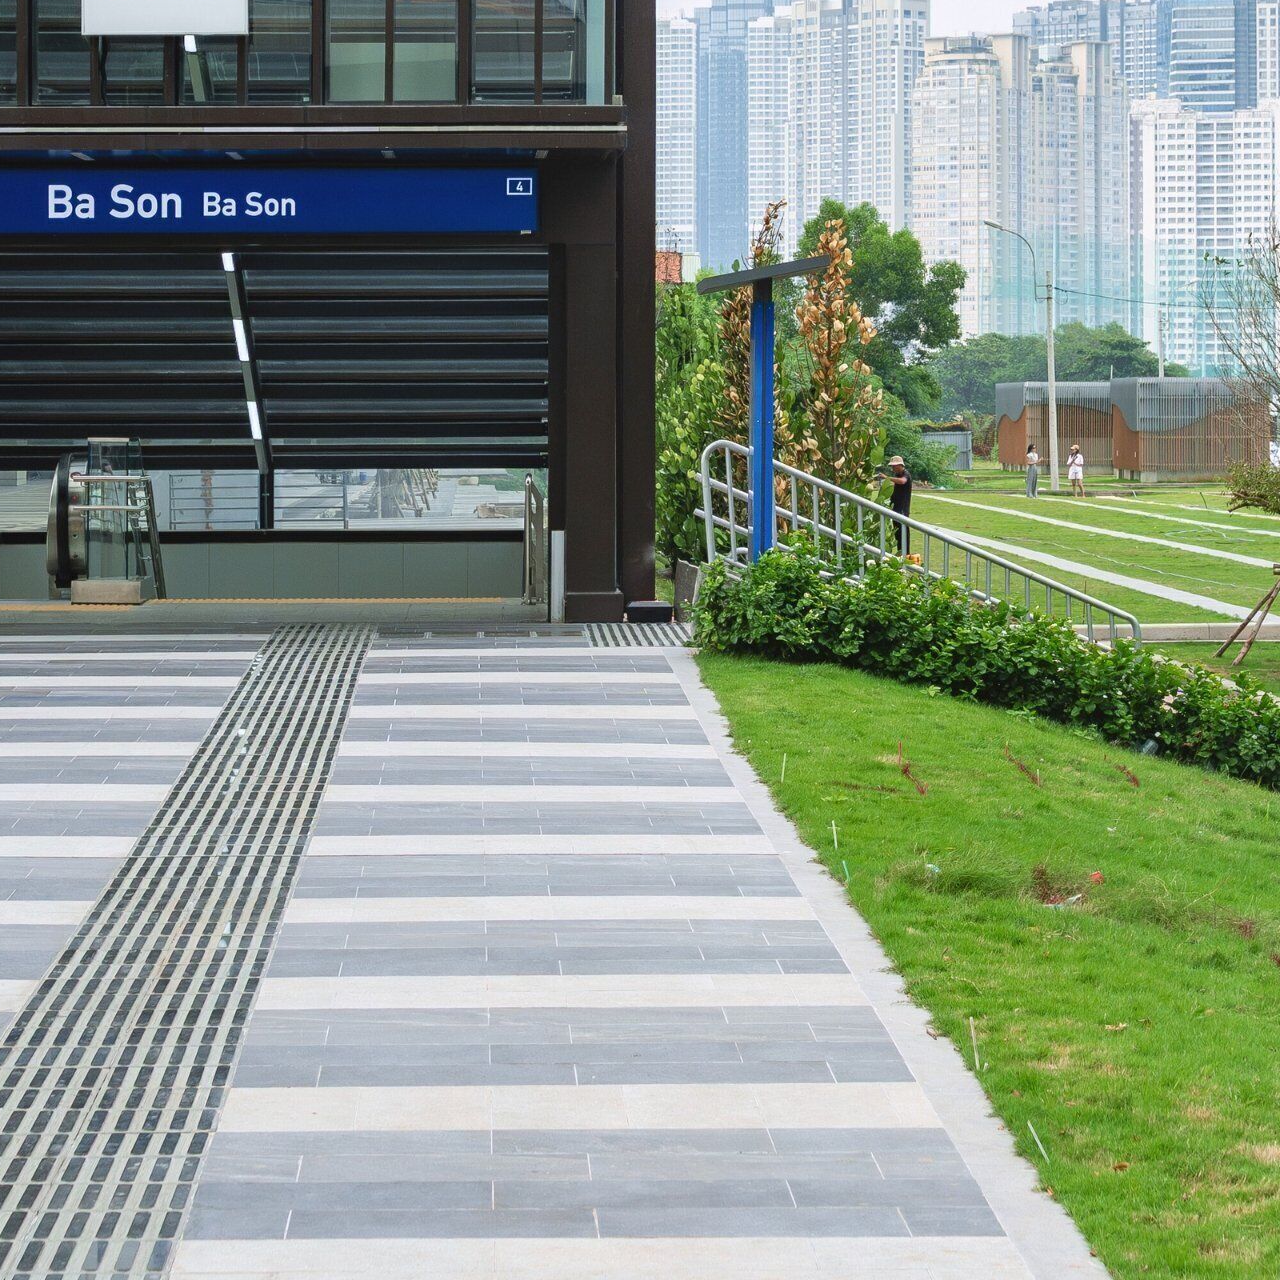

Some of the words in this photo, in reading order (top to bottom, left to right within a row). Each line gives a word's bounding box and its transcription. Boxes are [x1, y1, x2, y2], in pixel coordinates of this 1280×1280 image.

[516, 181, 524, 192] 4
[48, 184, 95, 219] Ba
[109, 183, 182, 219] Son
[203, 191, 237, 217] Ba
[245, 191, 296, 217] Son
